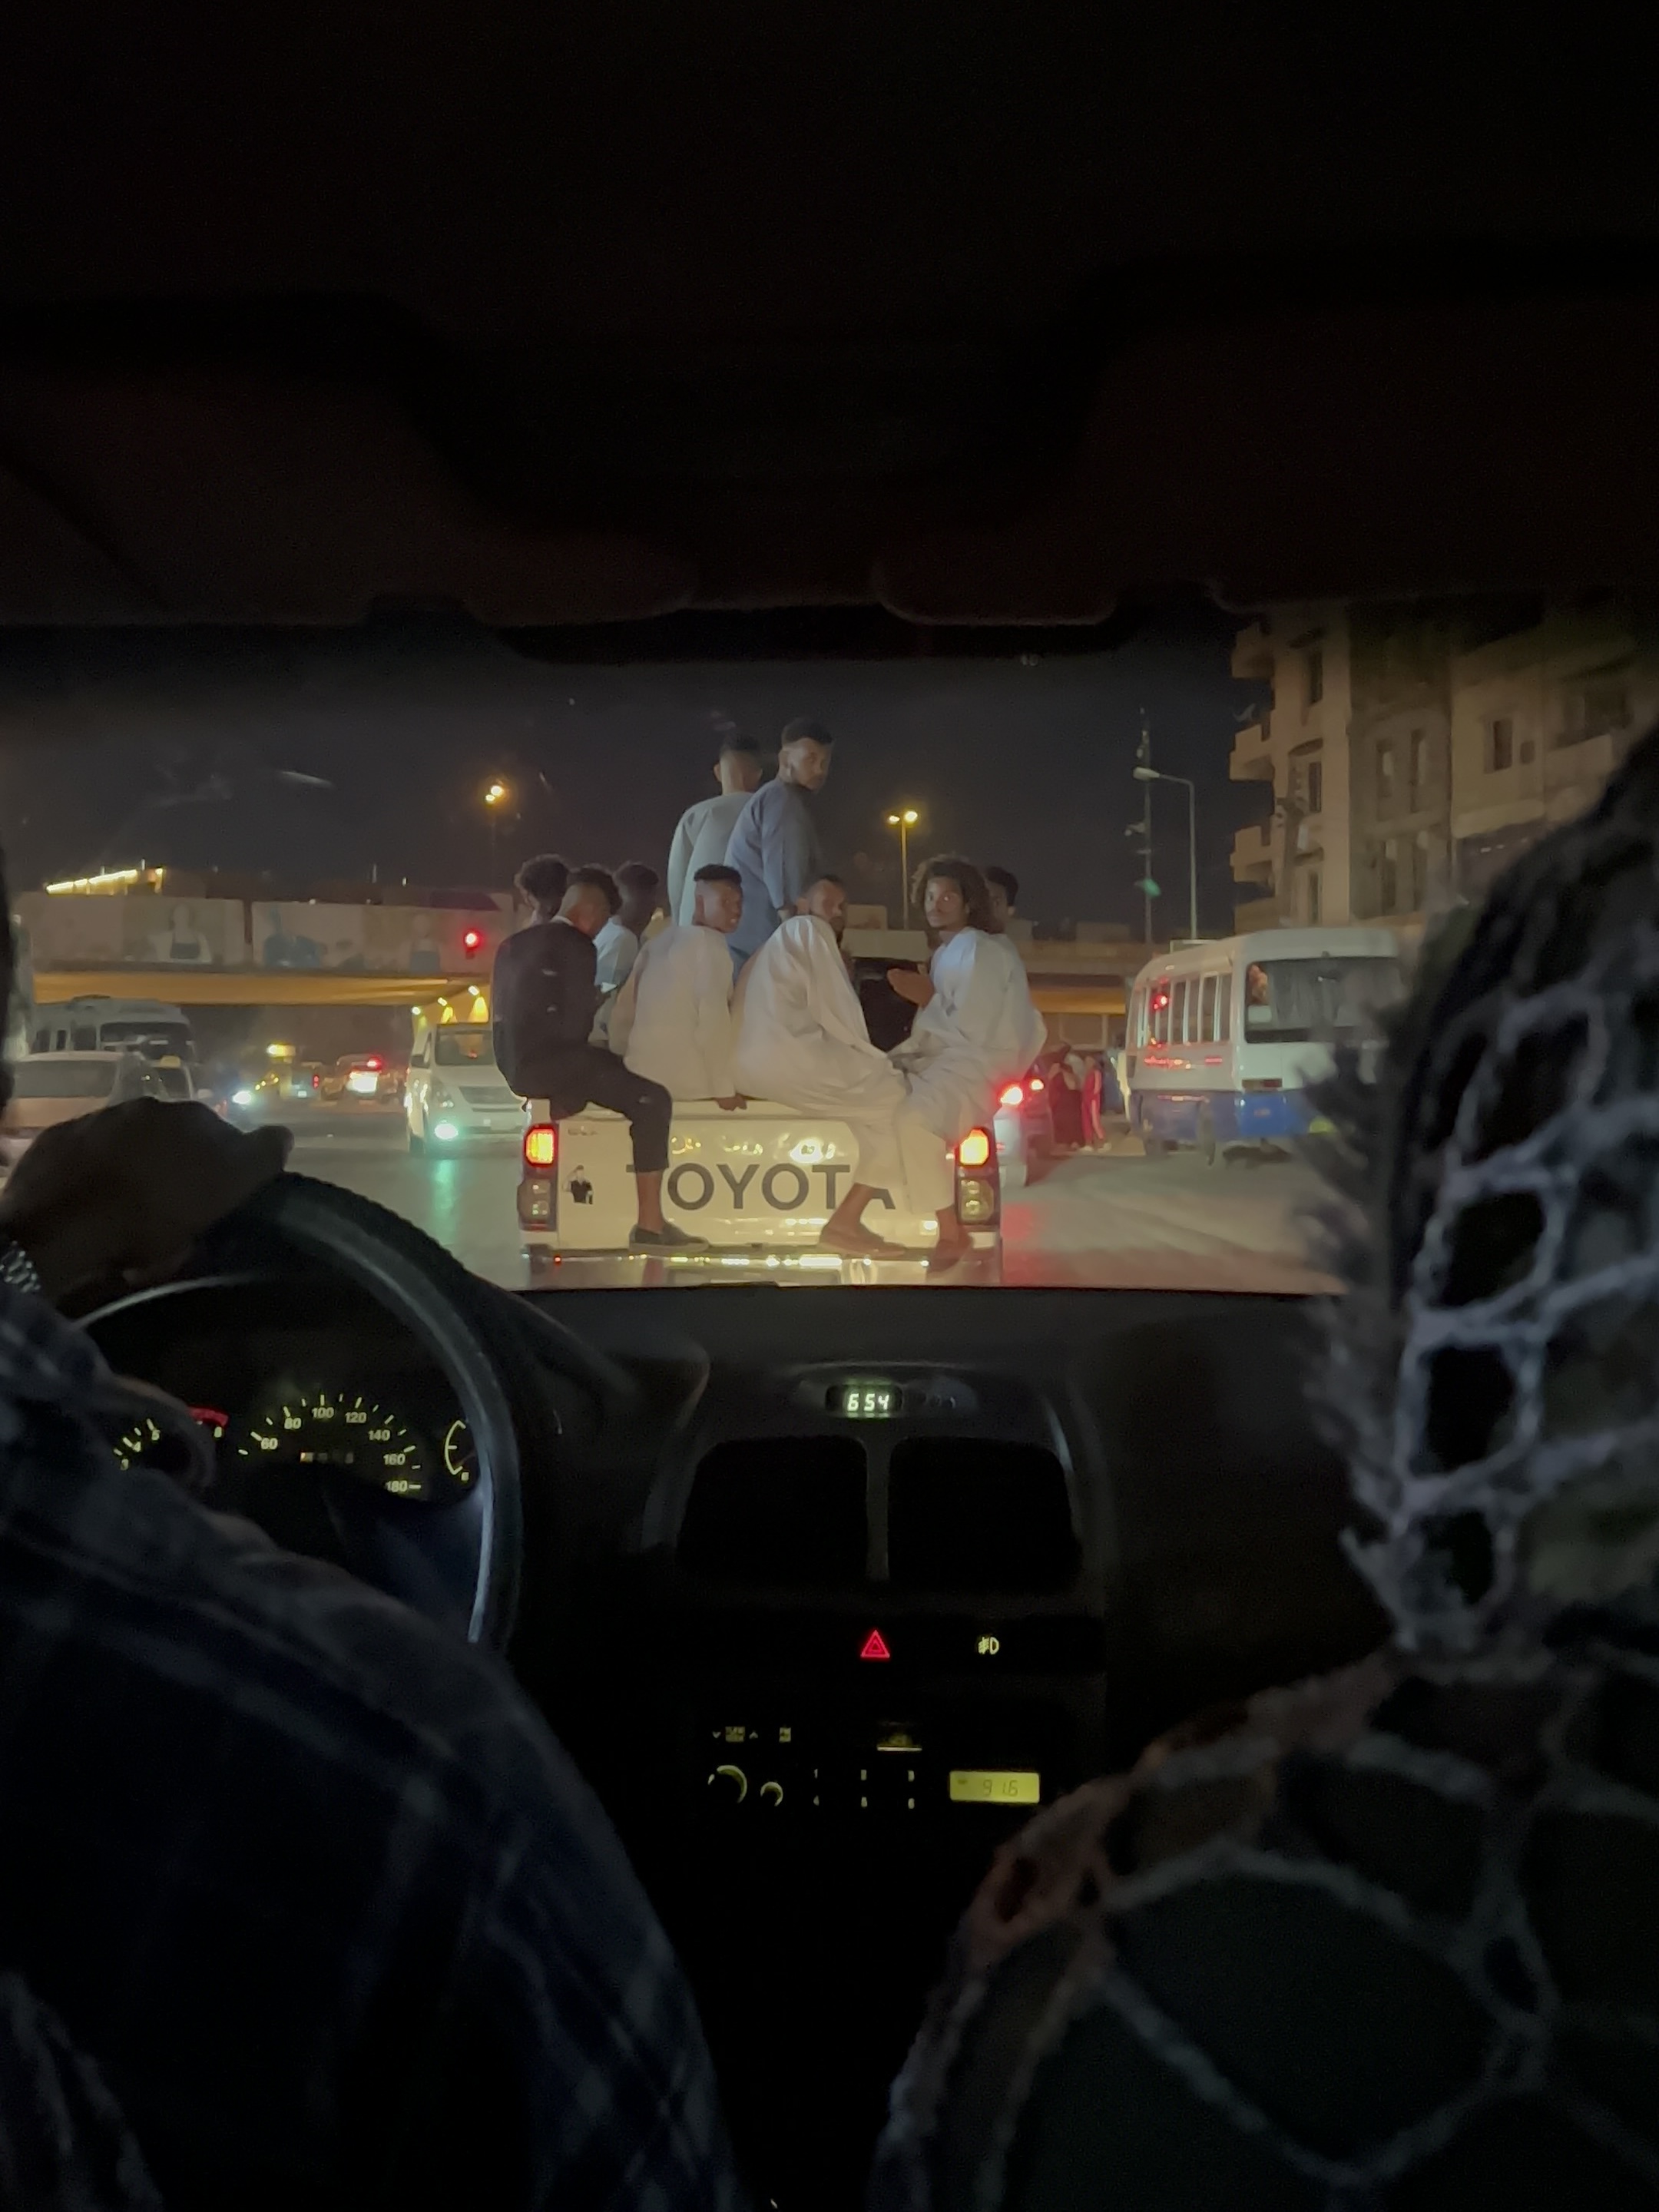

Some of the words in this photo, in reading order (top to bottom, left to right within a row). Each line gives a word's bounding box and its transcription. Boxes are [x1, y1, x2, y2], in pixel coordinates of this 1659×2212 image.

[626, 1163, 896, 1210] OYOT
[847, 1393, 890, 1412] 654
[312, 1406, 335, 1419] 100
[345, 1412, 367, 1423] 120
[284, 1417, 302, 1429] 80
[368, 1429, 391, 1441] 140
[261, 1437, 278, 1450] 60
[383, 1453, 406, 1465] 160
[386, 1480, 408, 1492] 180
